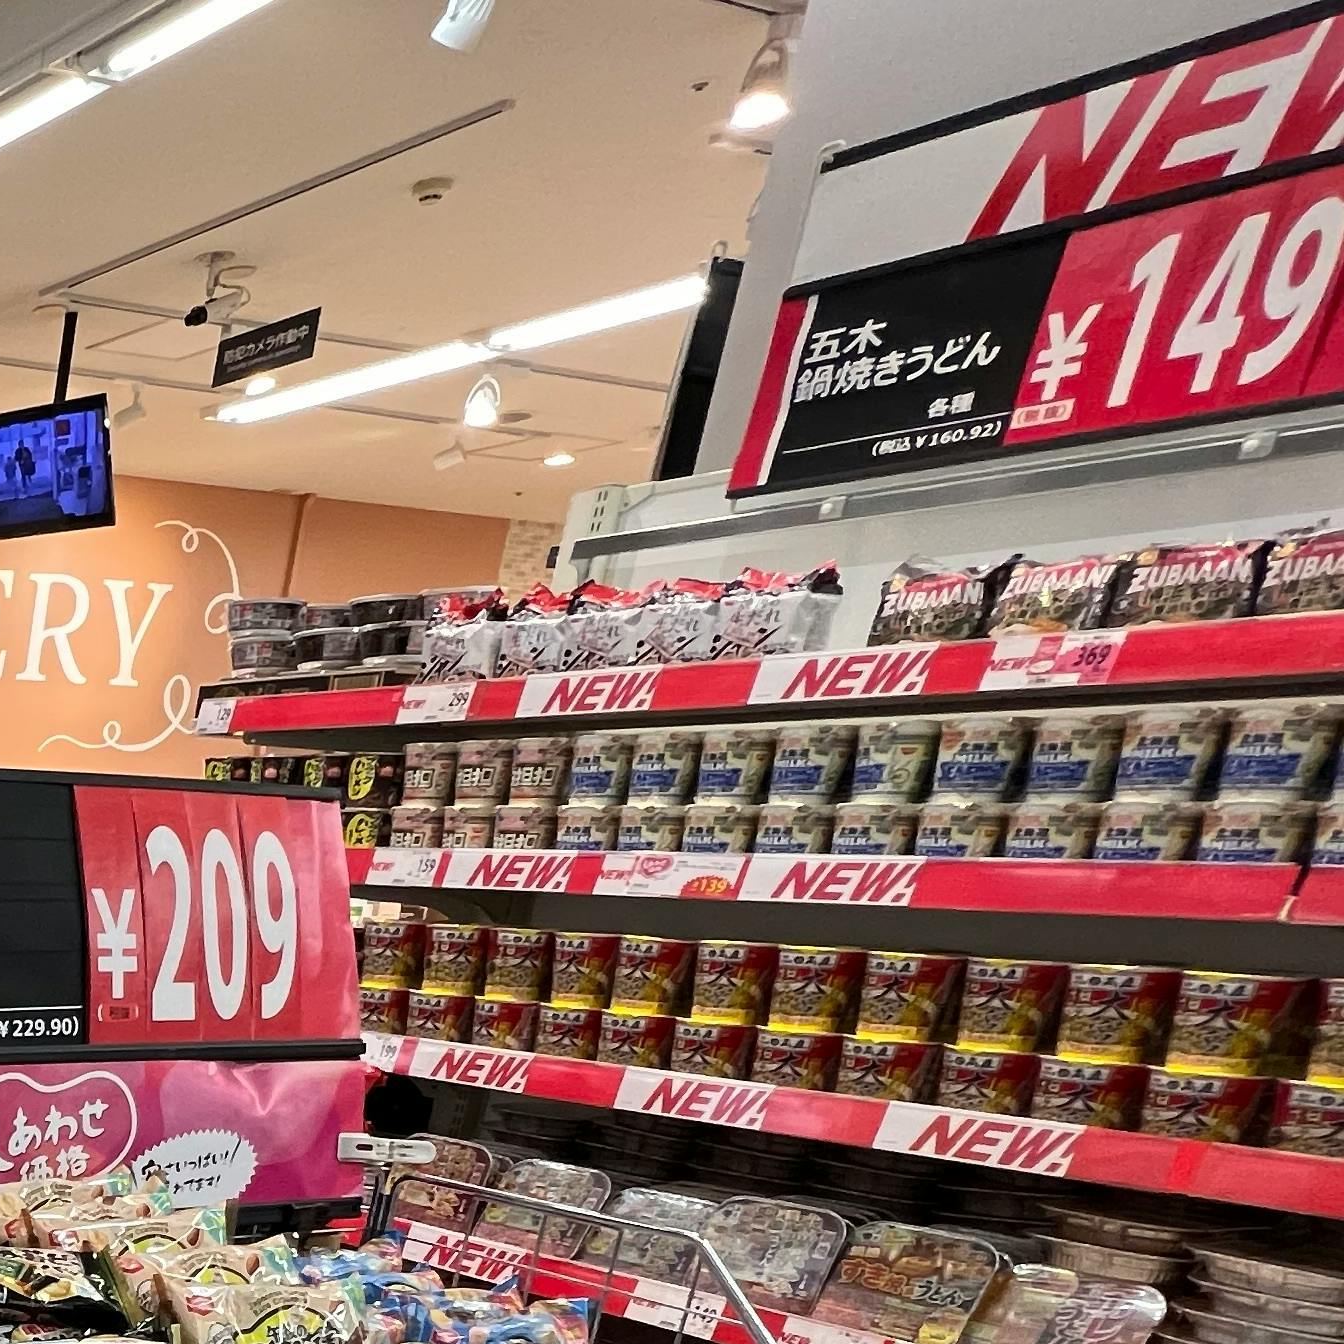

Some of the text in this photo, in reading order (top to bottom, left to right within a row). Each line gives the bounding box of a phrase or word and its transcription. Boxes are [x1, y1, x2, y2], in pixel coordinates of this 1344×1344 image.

[967, 15, 1344, 243] NE
[803, 318, 887, 364] 五木
[793, 331, 1001, 403] 鍋焼きうどん
[780, 649, 939, 699] NEW!
[1072, 643, 1112, 668] 369
[541, 671, 662, 713] NEW!
[465, 853, 574, 890] NEW!
[770, 861, 923, 904] NEW!
[91, 825, 301, 1022] ¥209
[430, 1047, 534, 1090] NEW!
[642, 1077, 770, 1127] NEW!
[19, 1144, 91, 1182] 価格
[909, 1113, 1079, 1173] NEW!
